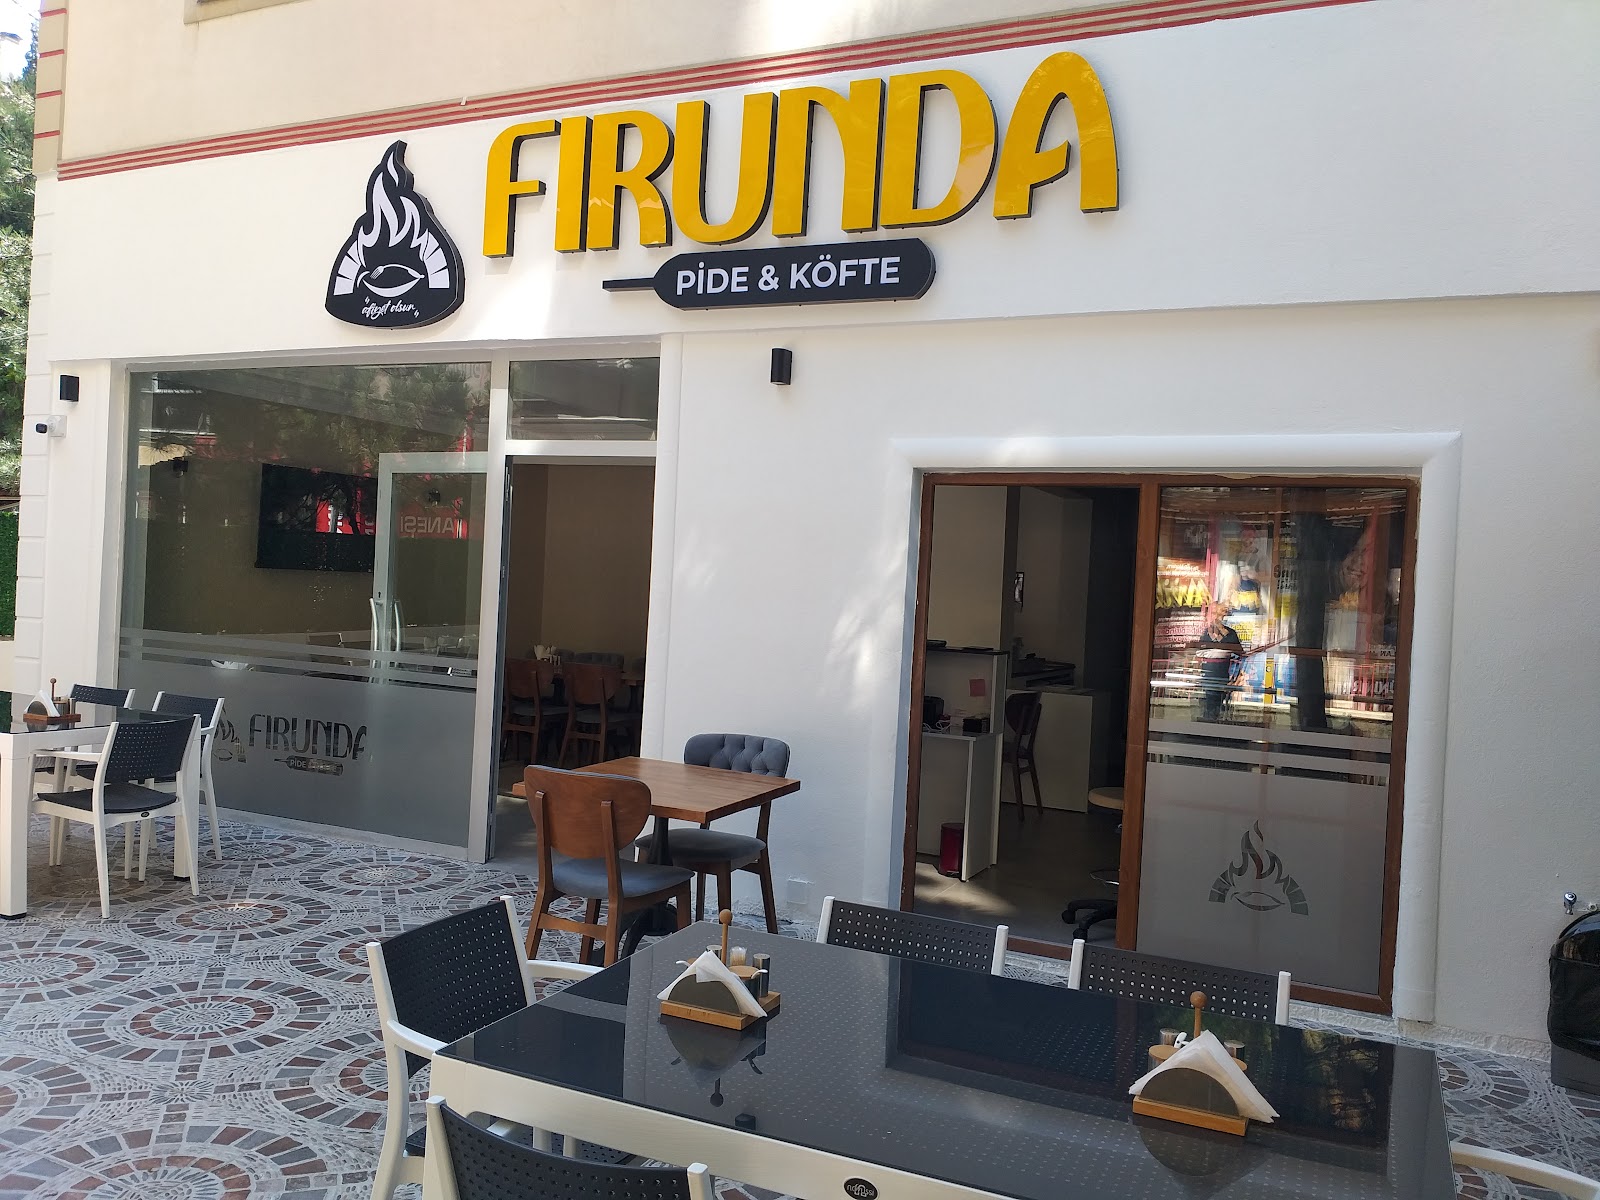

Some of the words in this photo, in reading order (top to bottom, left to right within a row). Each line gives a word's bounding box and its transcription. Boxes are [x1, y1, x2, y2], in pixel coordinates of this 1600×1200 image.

[483, 51, 1119, 258] FIRUNDA
[676, 261, 750, 296] PİDE
[757, 264, 780, 291] &
[789, 254, 901, 290] KÖFTE
